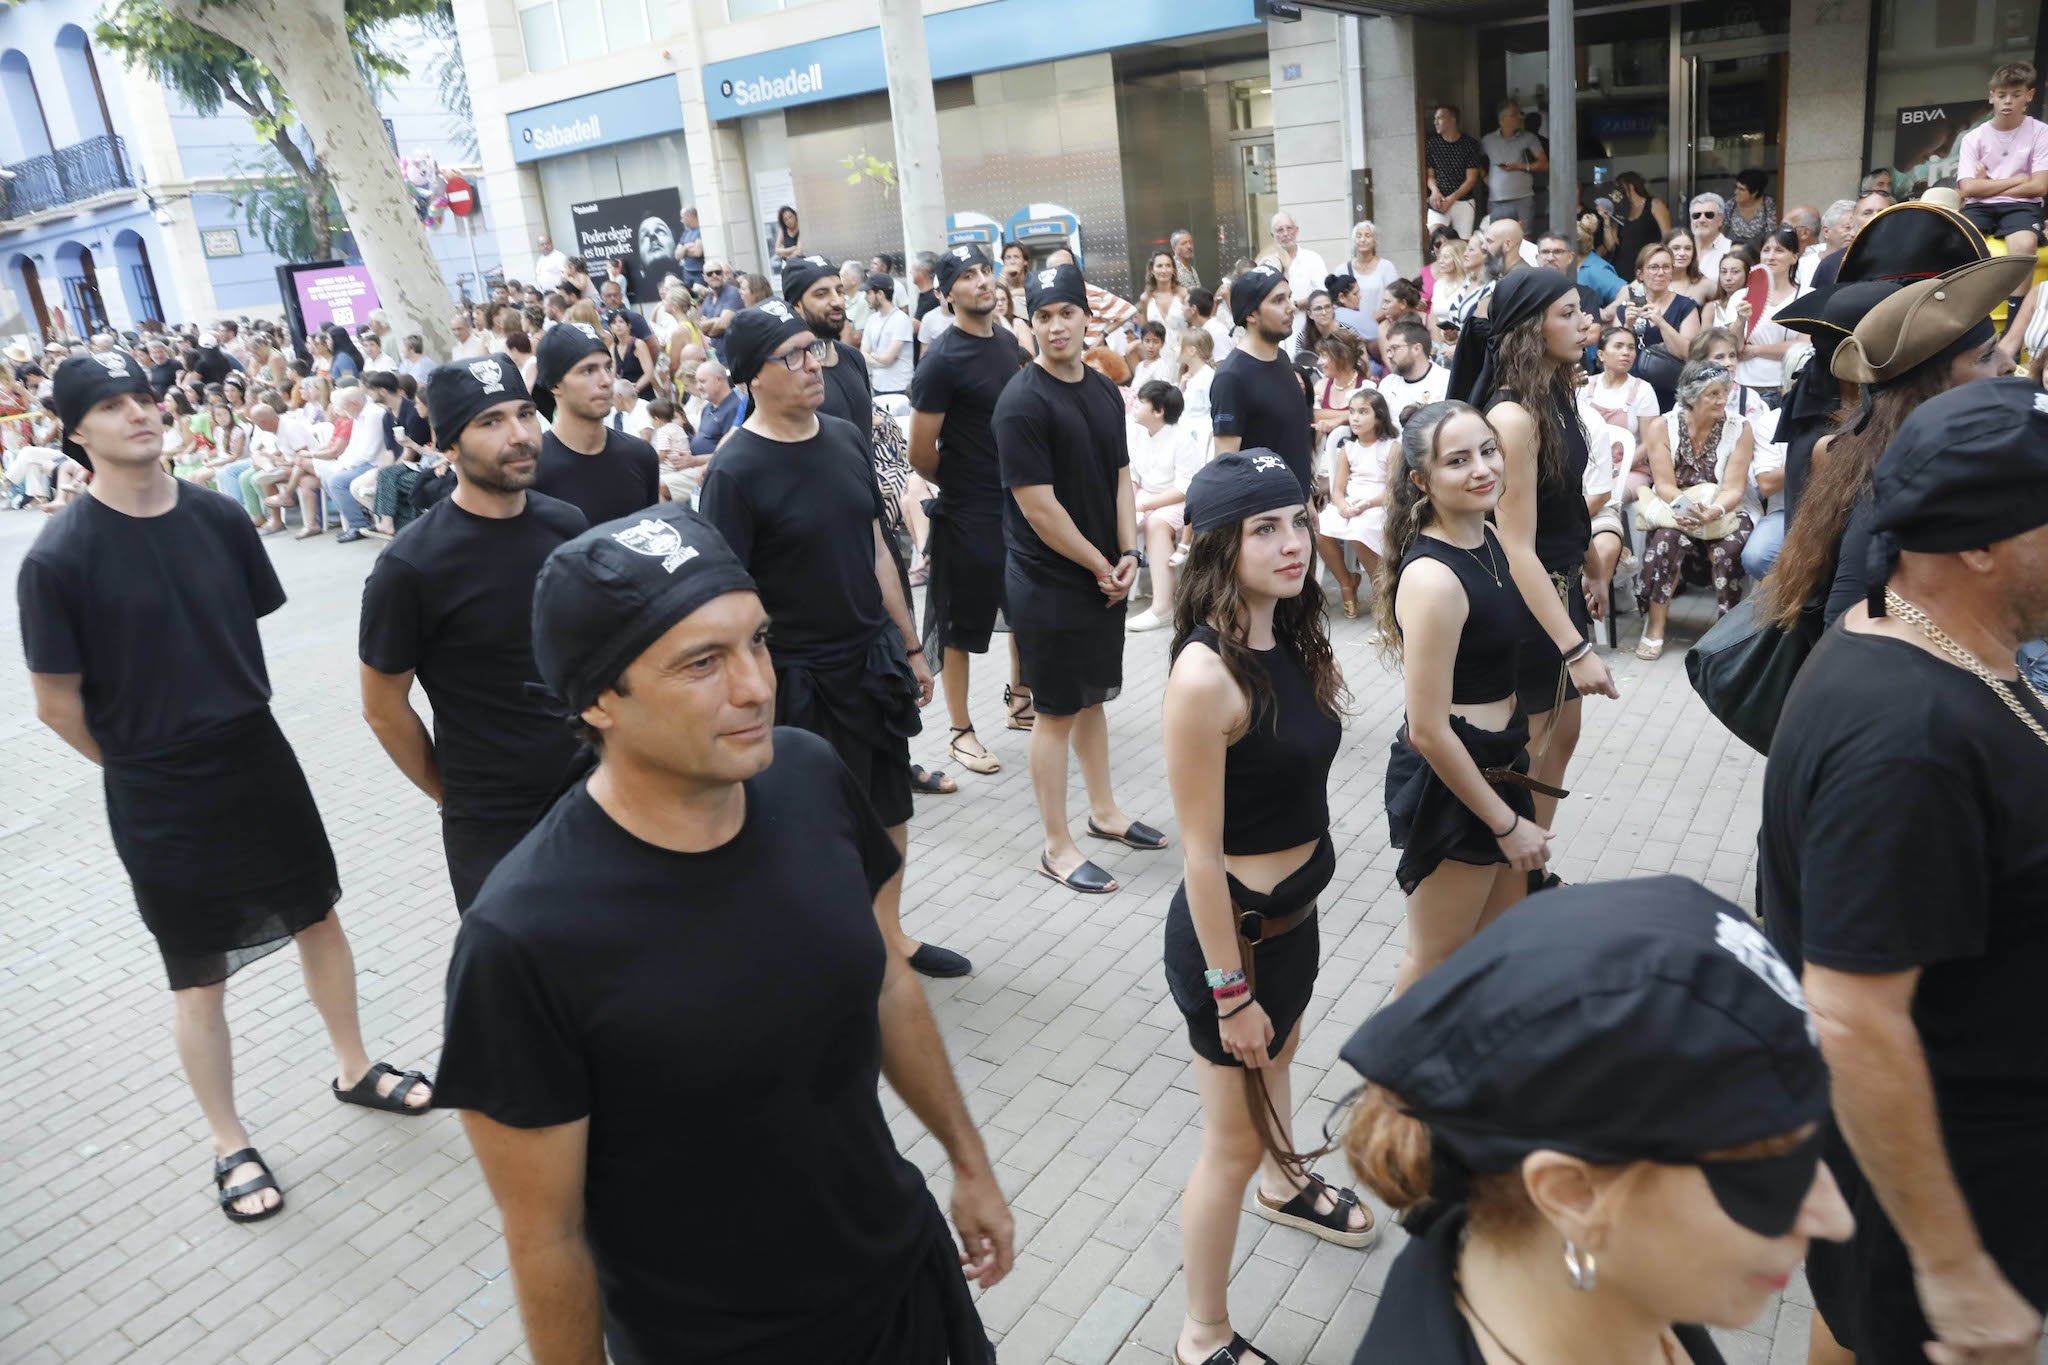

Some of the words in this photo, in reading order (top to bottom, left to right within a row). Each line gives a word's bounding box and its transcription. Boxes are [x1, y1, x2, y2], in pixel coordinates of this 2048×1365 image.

[734, 63, 823, 106] Sabadell
[1902, 108, 1946, 124] BBVA
[533, 113, 601, 150] Sabadell
[581, 228, 607, 245] Poder
[607, 225, 633, 242] elegir
[584, 248, 595, 259] es
[594, 245, 605, 258] tu
[604, 240, 634, 260] poder.
